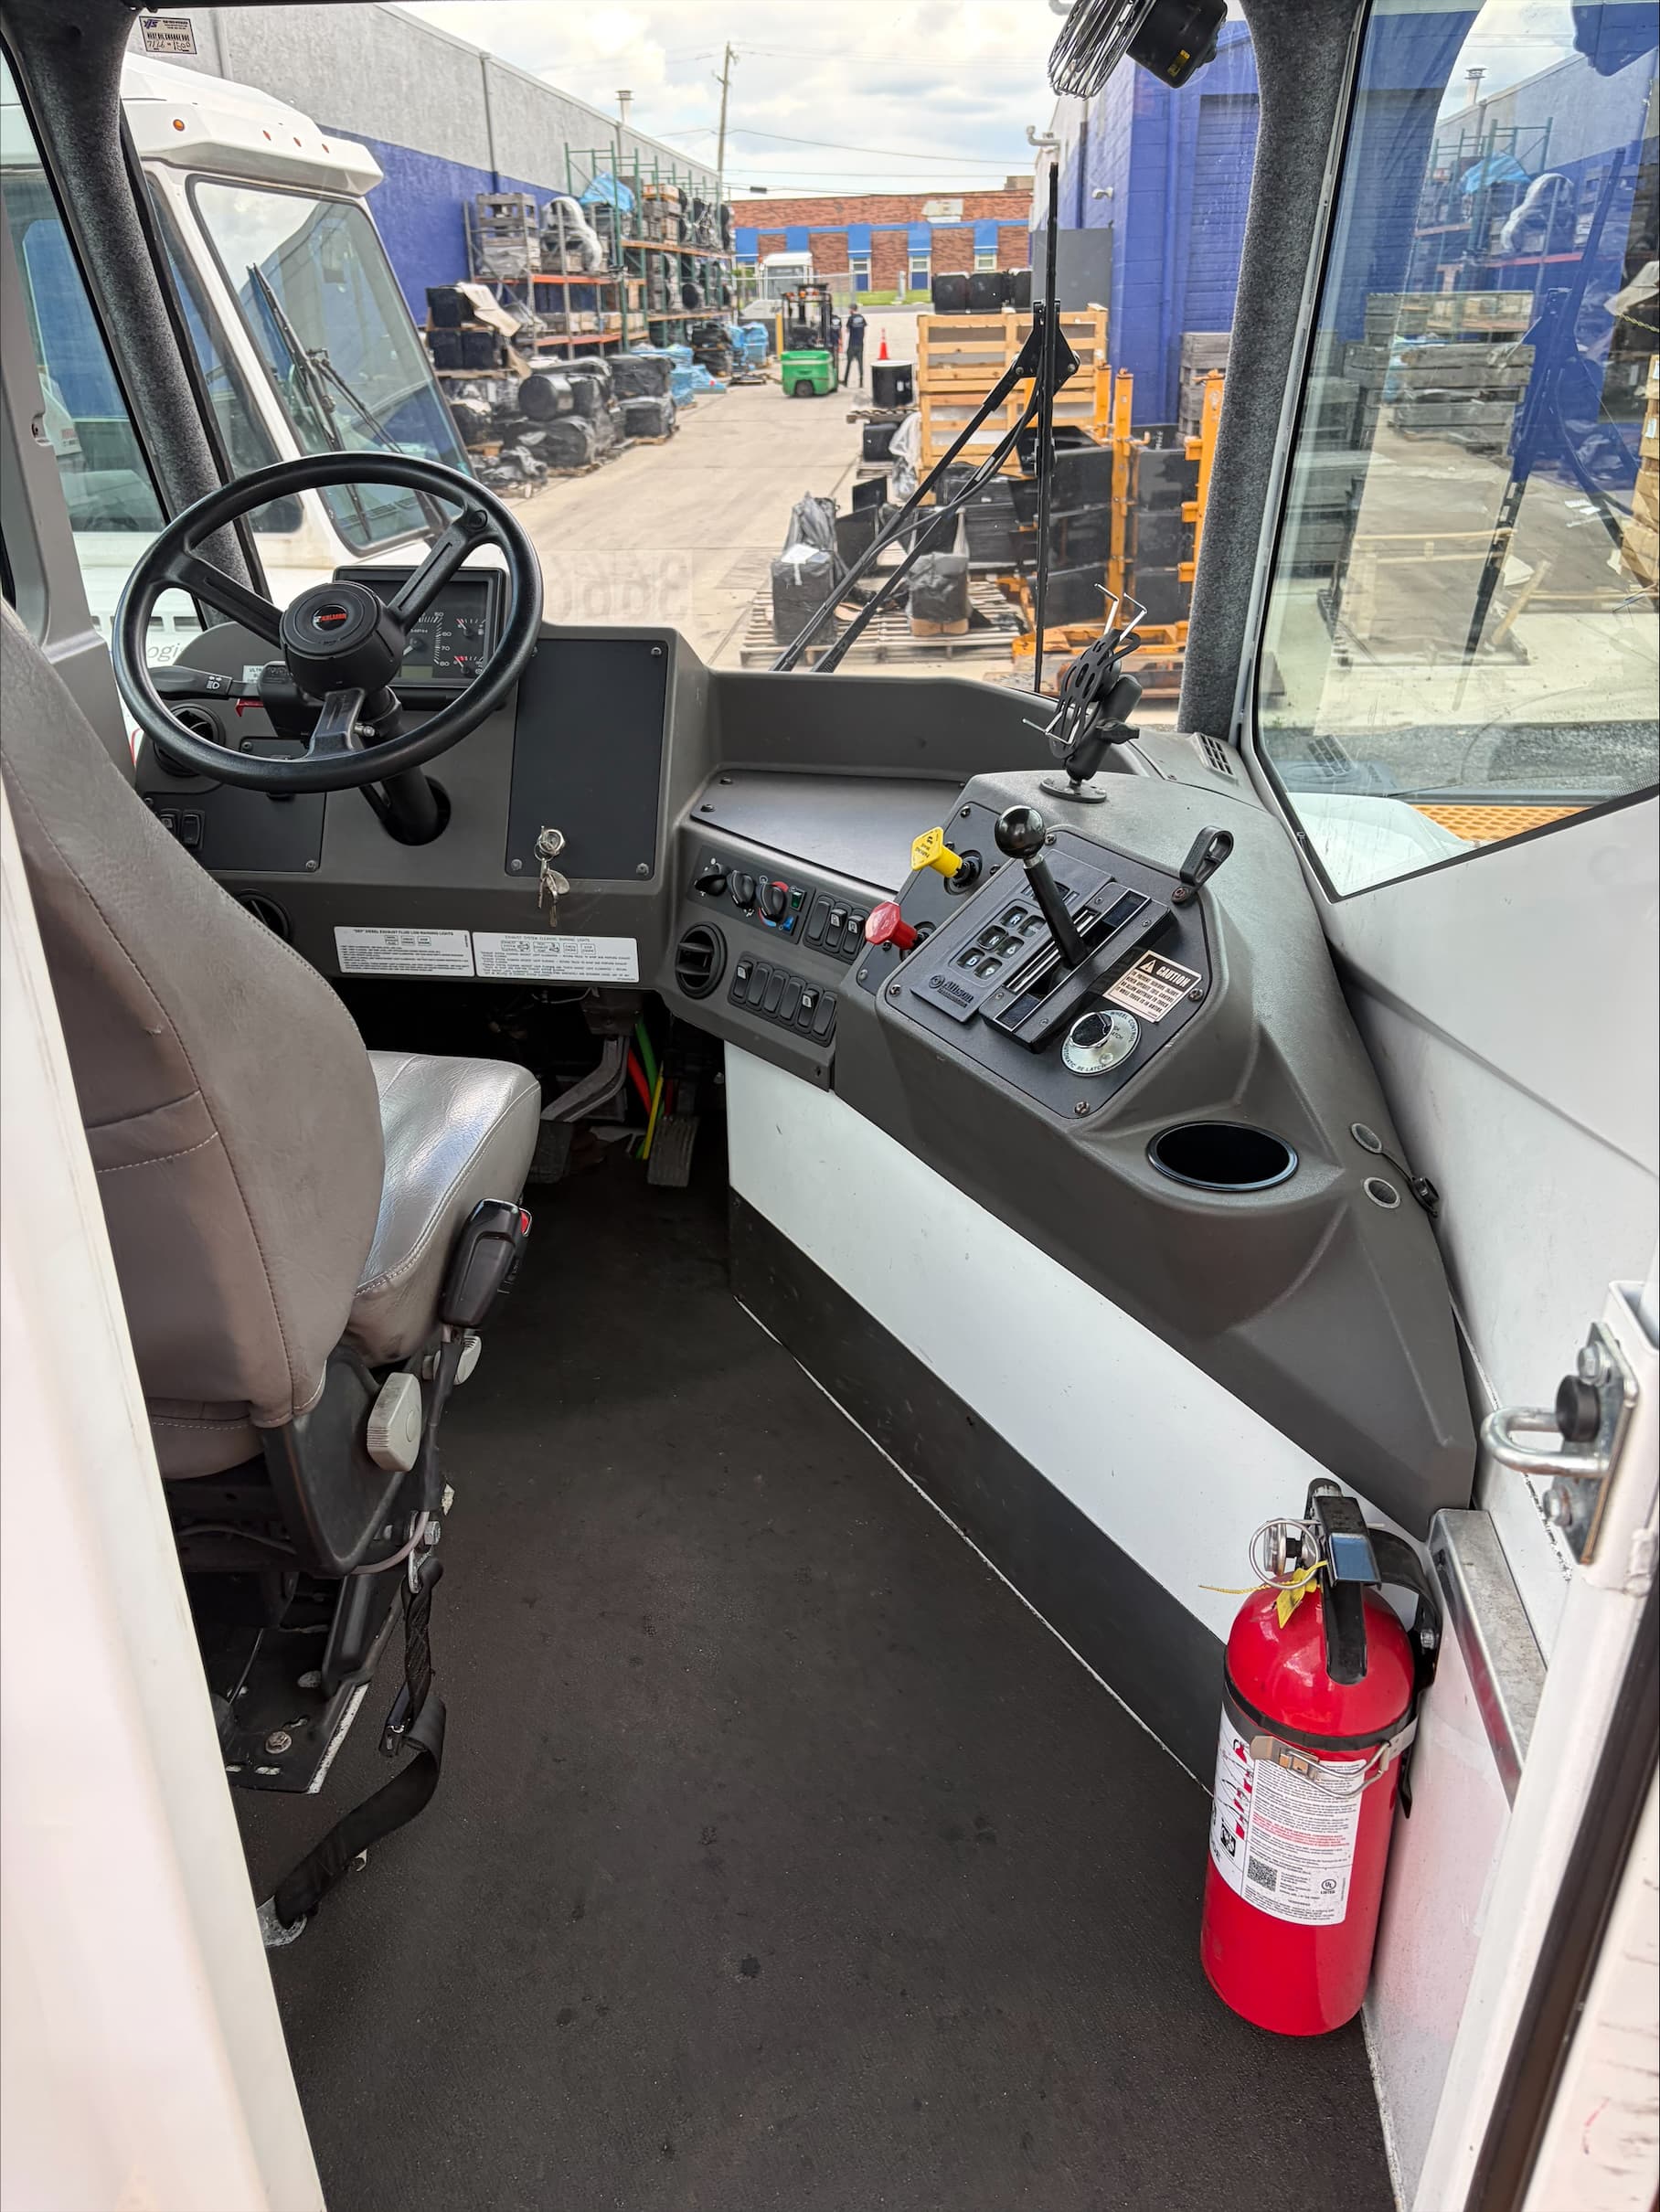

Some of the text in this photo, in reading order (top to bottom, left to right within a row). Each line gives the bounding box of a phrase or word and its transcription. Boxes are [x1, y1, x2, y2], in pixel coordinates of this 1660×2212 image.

[1010, 915, 1020, 925] R
[989, 936, 1000, 945] N
[967, 957, 978, 966] D
[1156, 966, 1190, 987] CAUTION
[944, 980, 974, 1003] Allison
[1110, 1011, 1137, 1043] WHEEL CONTROL
